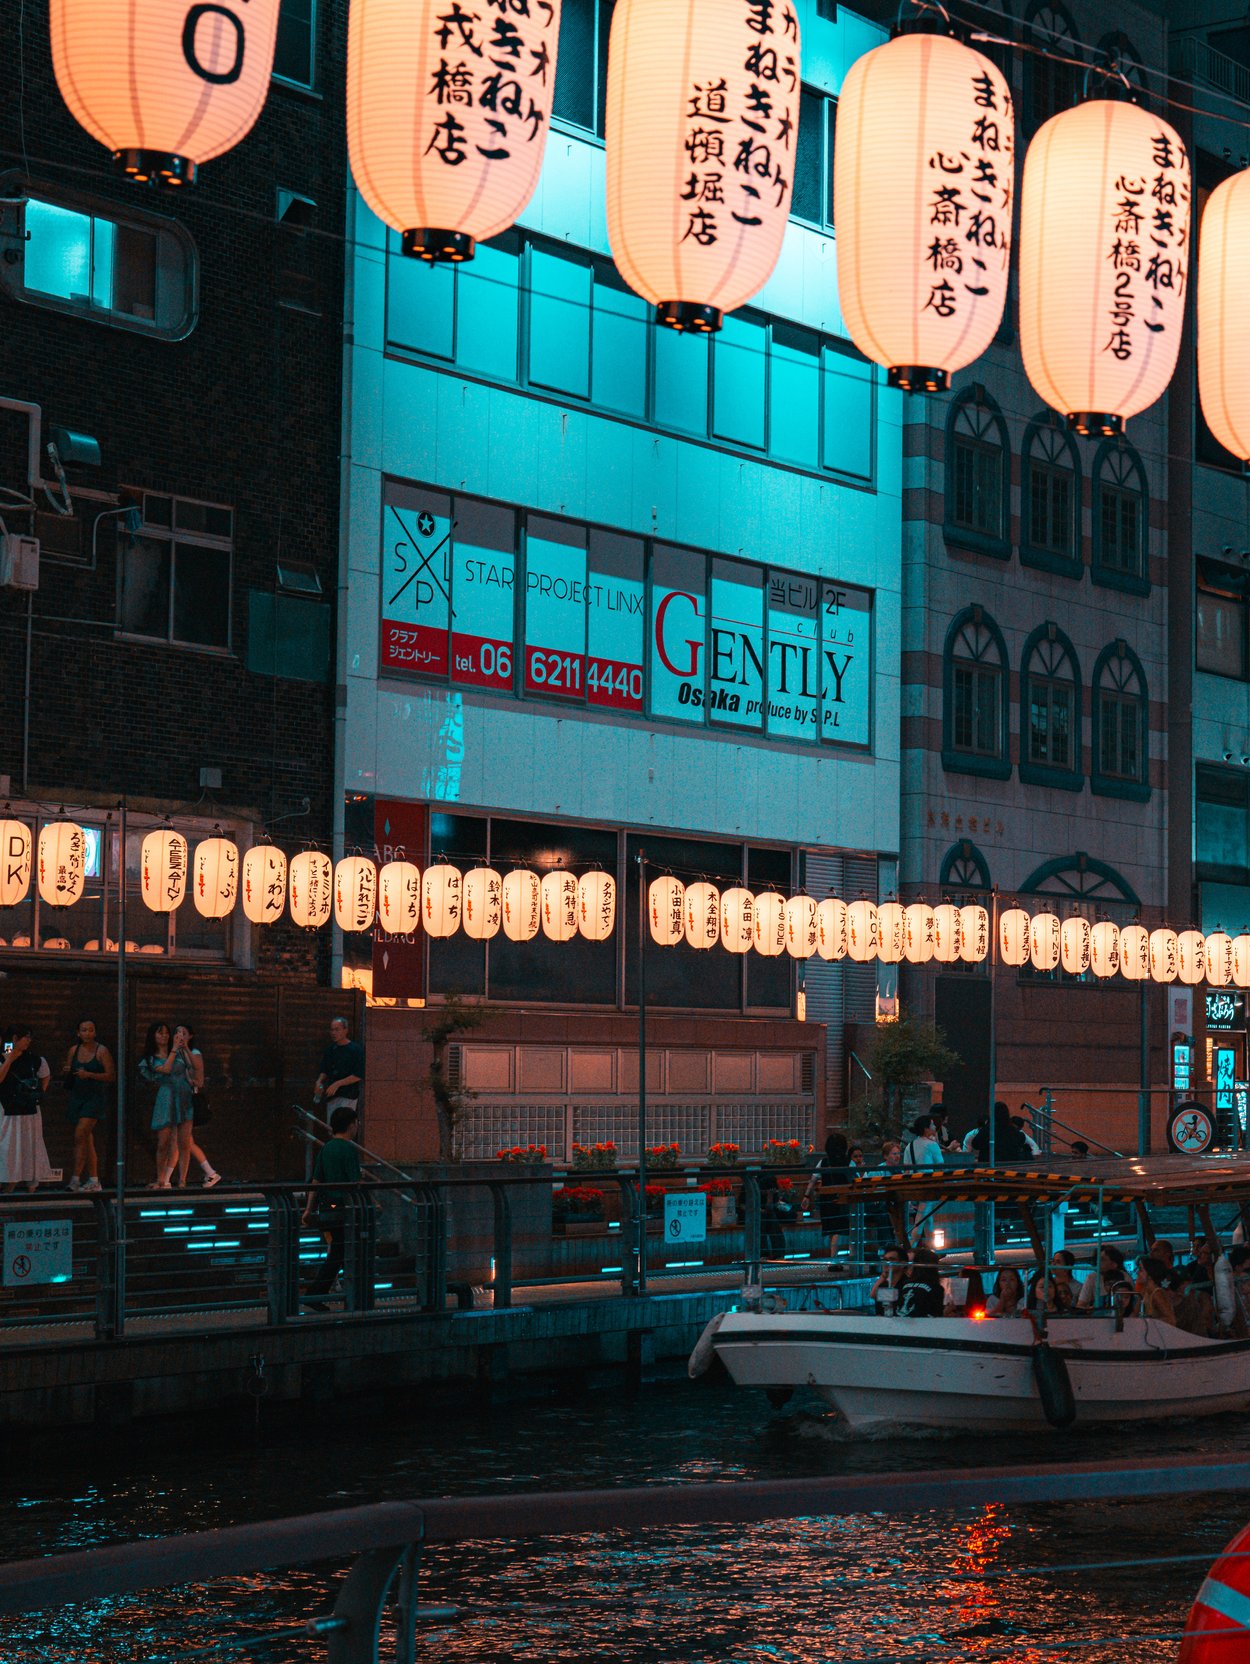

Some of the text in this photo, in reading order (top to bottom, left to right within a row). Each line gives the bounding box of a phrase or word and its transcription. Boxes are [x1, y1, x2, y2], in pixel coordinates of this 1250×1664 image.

[424, 2, 483, 166] 戎橋店
[731, 0, 780, 227] まねきねこ
[678, 77, 734, 246] 道頓堀店
[964, 69, 1001, 298] まねきねこ
[923, 151, 968, 318] 心斎橋店
[1143, 132, 1178, 334] まねきねこ
[1102, 174, 1146, 362] 心斎橋2号店
[465, 559, 645, 616] STAR PROJECT LINX
[770, 579, 847, 617] 当ビル 2F
[388, 645, 441, 664] ジェントリー
[389, 629, 418, 645] クラブ
[654, 591, 855, 704] GENTLY
[455, 643, 643, 700] tel. 06 6211 4440
[677, 682, 741, 713] Osaka
[794, 704, 809, 724] by
[810, 710, 840, 727] SP.L
[563, 880, 576, 926] 超特急
[706, 891, 718, 938] 木全翔也
[868, 909, 878, 948] NOA
